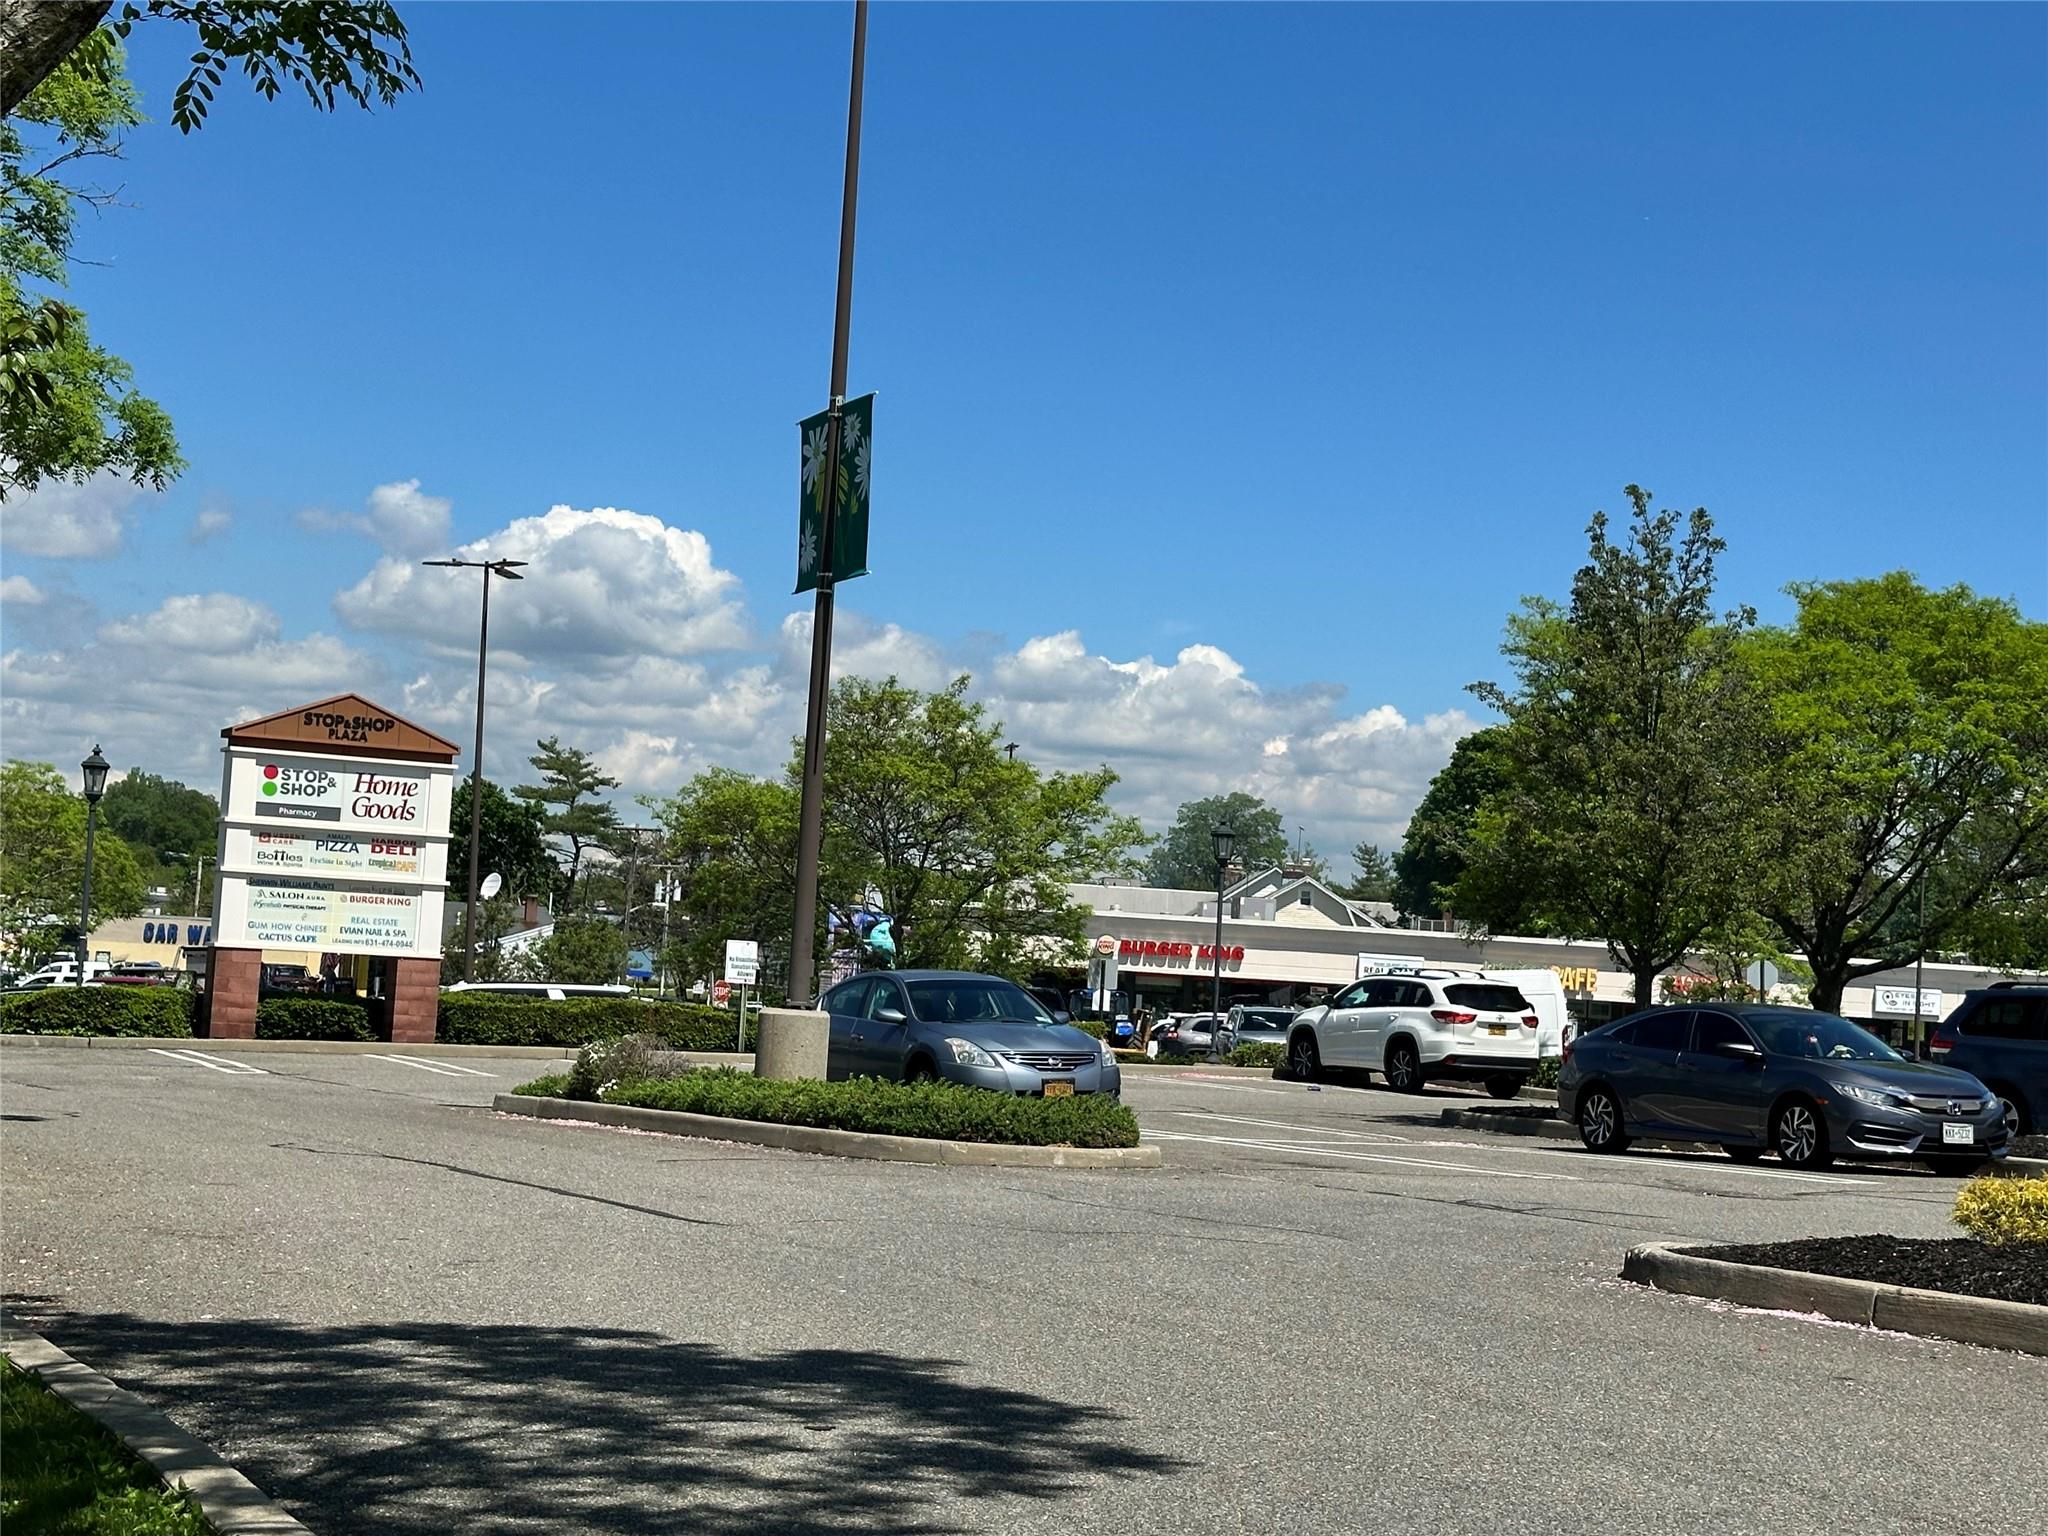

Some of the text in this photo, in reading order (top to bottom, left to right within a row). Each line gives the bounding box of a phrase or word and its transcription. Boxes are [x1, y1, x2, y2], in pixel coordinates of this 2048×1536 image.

[328, 728, 368, 743] PLAZA
[281, 768, 329, 784] STOP
[280, 783, 328, 798] SHOP
[352, 772, 419, 797] Home
[278, 806, 318, 818] Pharmacy
[351, 796, 416, 821] Goods
[315, 839, 359, 854] PIZZA
[371, 837, 417, 847] HARBOR
[370, 844, 417, 857] DELI
[269, 891, 305, 900] SALON
[349, 895, 411, 907] BURGER KING
[247, 920, 328, 933] GUM HOW CHINESE
[350, 916, 400, 927] REAL ESTATE
[143, 922, 179, 945] CAR
[258, 932, 318, 943] CACTUS CAFE
[339, 926, 407, 938] EVIAN NAIL & SPA
[1119, 939, 1246, 962] BURGER KING
[714, 986, 729, 996] STOP
